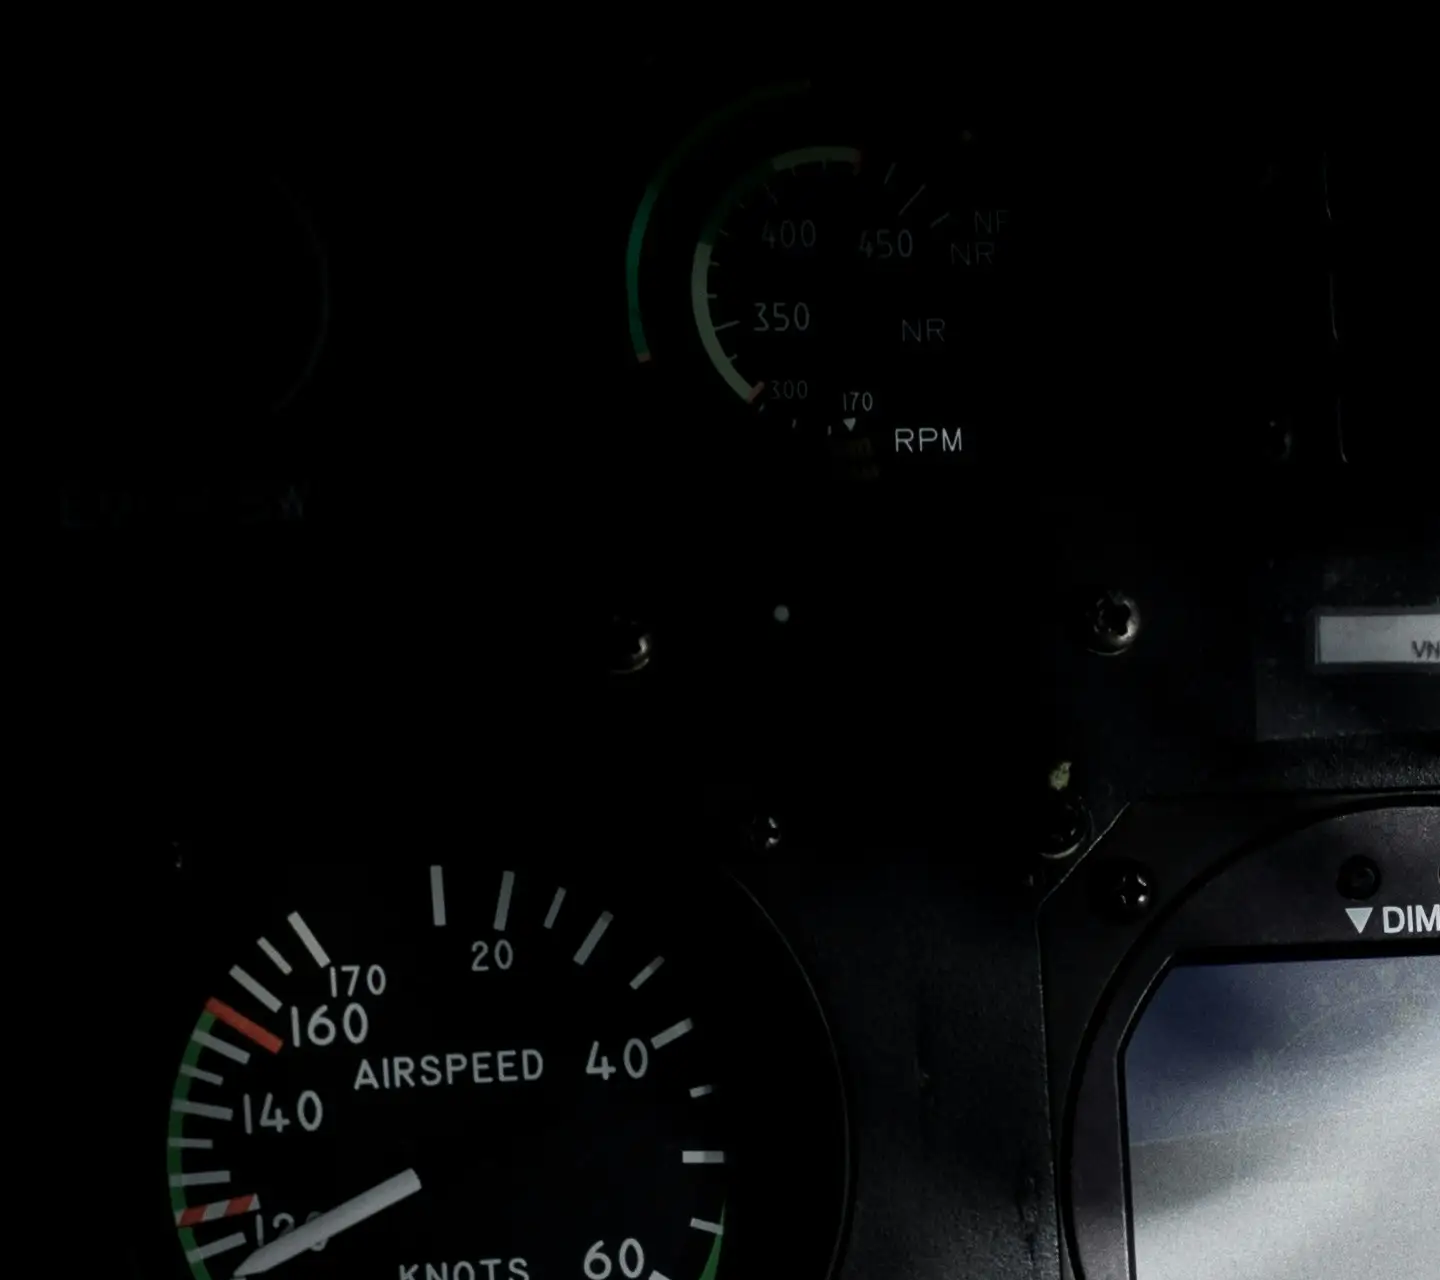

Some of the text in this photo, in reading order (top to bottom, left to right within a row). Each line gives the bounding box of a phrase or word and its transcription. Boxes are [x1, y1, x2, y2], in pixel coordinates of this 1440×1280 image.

[760, 218, 817, 250] 400
[859, 228, 914, 260] 450
[752, 301, 810, 332] 350
[893, 426, 963, 453] RPM
[471, 939, 514, 971] 20
[330, 964, 386, 999] 170
[289, 1002, 370, 1048] 160
[353, 1048, 544, 1091] AIRSPEED
[585, 1037, 649, 1080] 40
[242, 1089, 323, 1135] 140
[582, 1237, 645, 1279] 60
